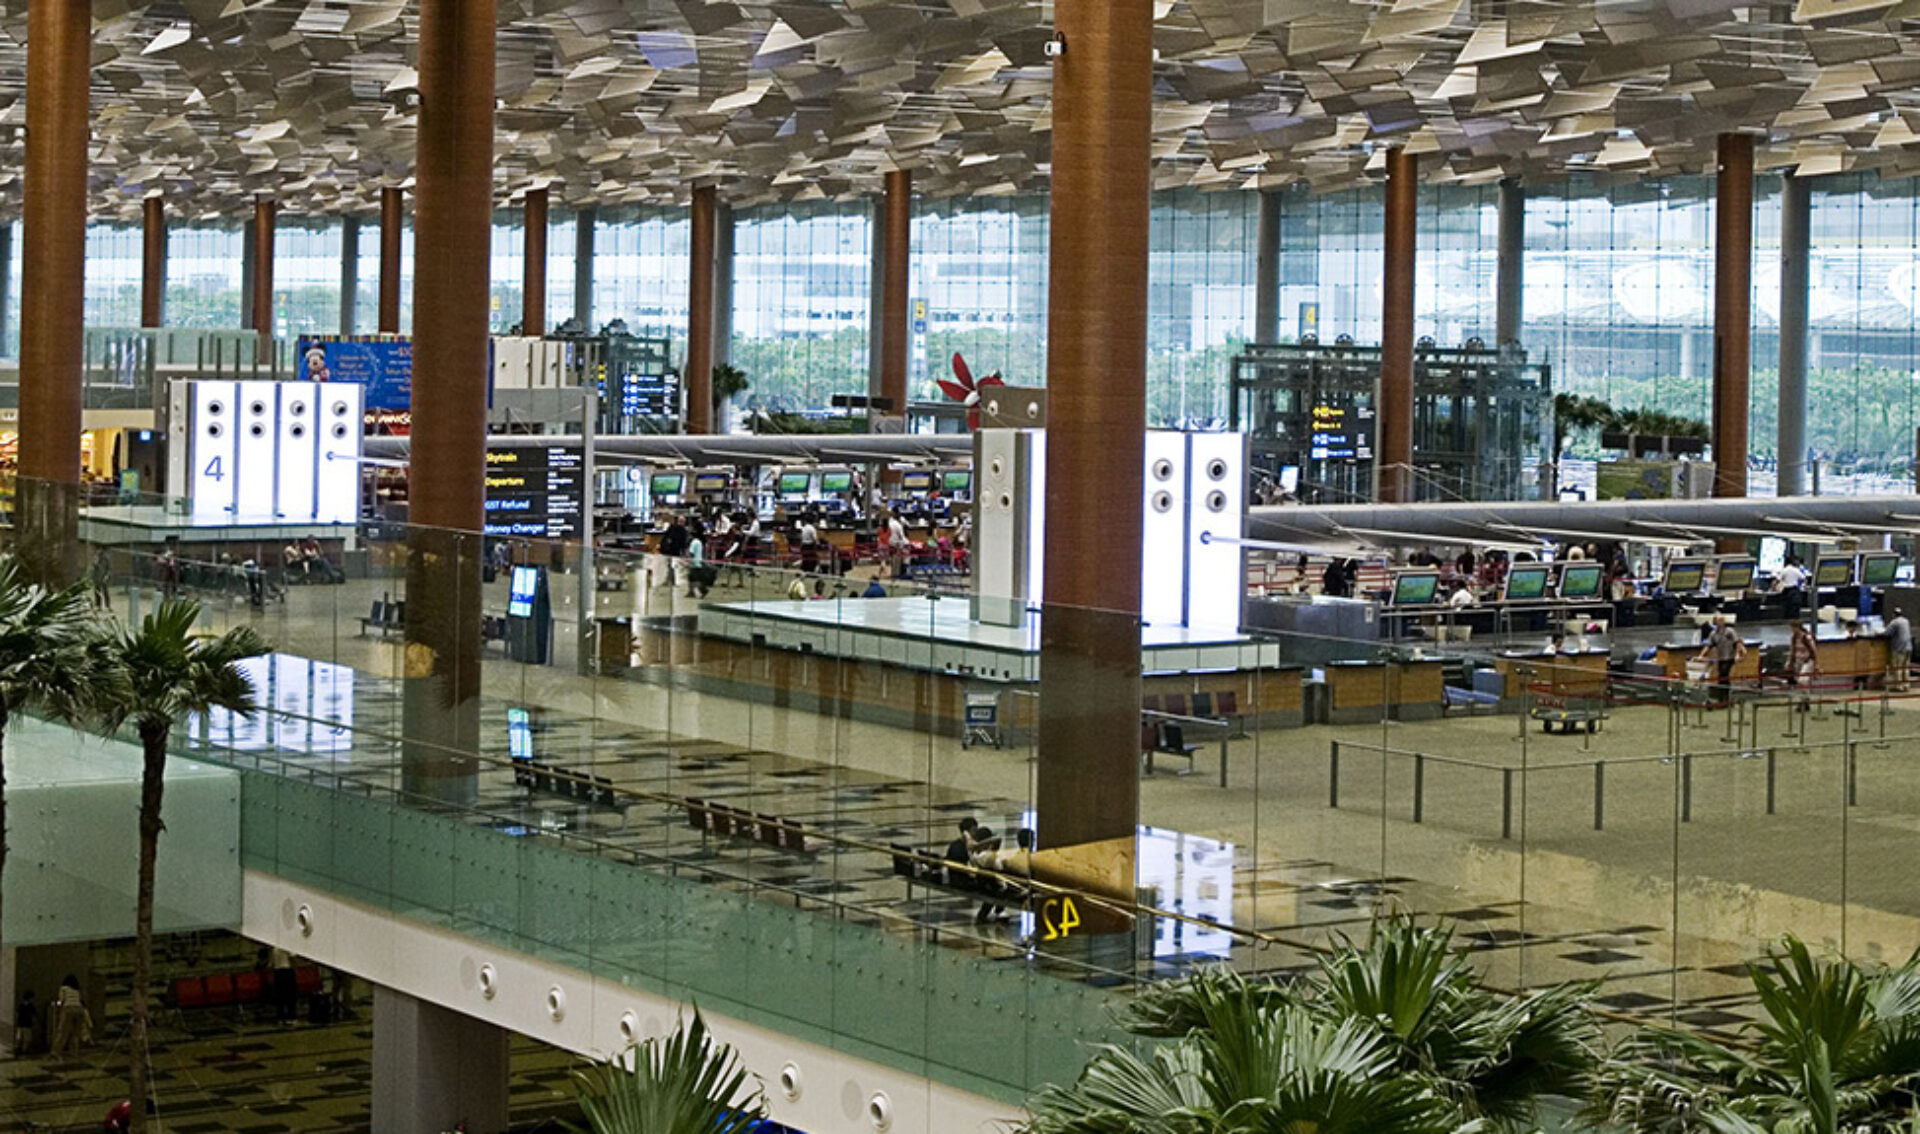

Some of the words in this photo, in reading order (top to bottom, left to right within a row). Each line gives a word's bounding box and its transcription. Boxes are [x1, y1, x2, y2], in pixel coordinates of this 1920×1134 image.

[485, 452, 518, 464] Skytrain
[203, 455, 225, 482] 4
[484, 477, 525, 488] Departure
[484, 500, 500, 510] GST
[501, 499, 530, 510] Refund
[484, 524, 511, 535] Money
[512, 523, 545, 535] Changer
